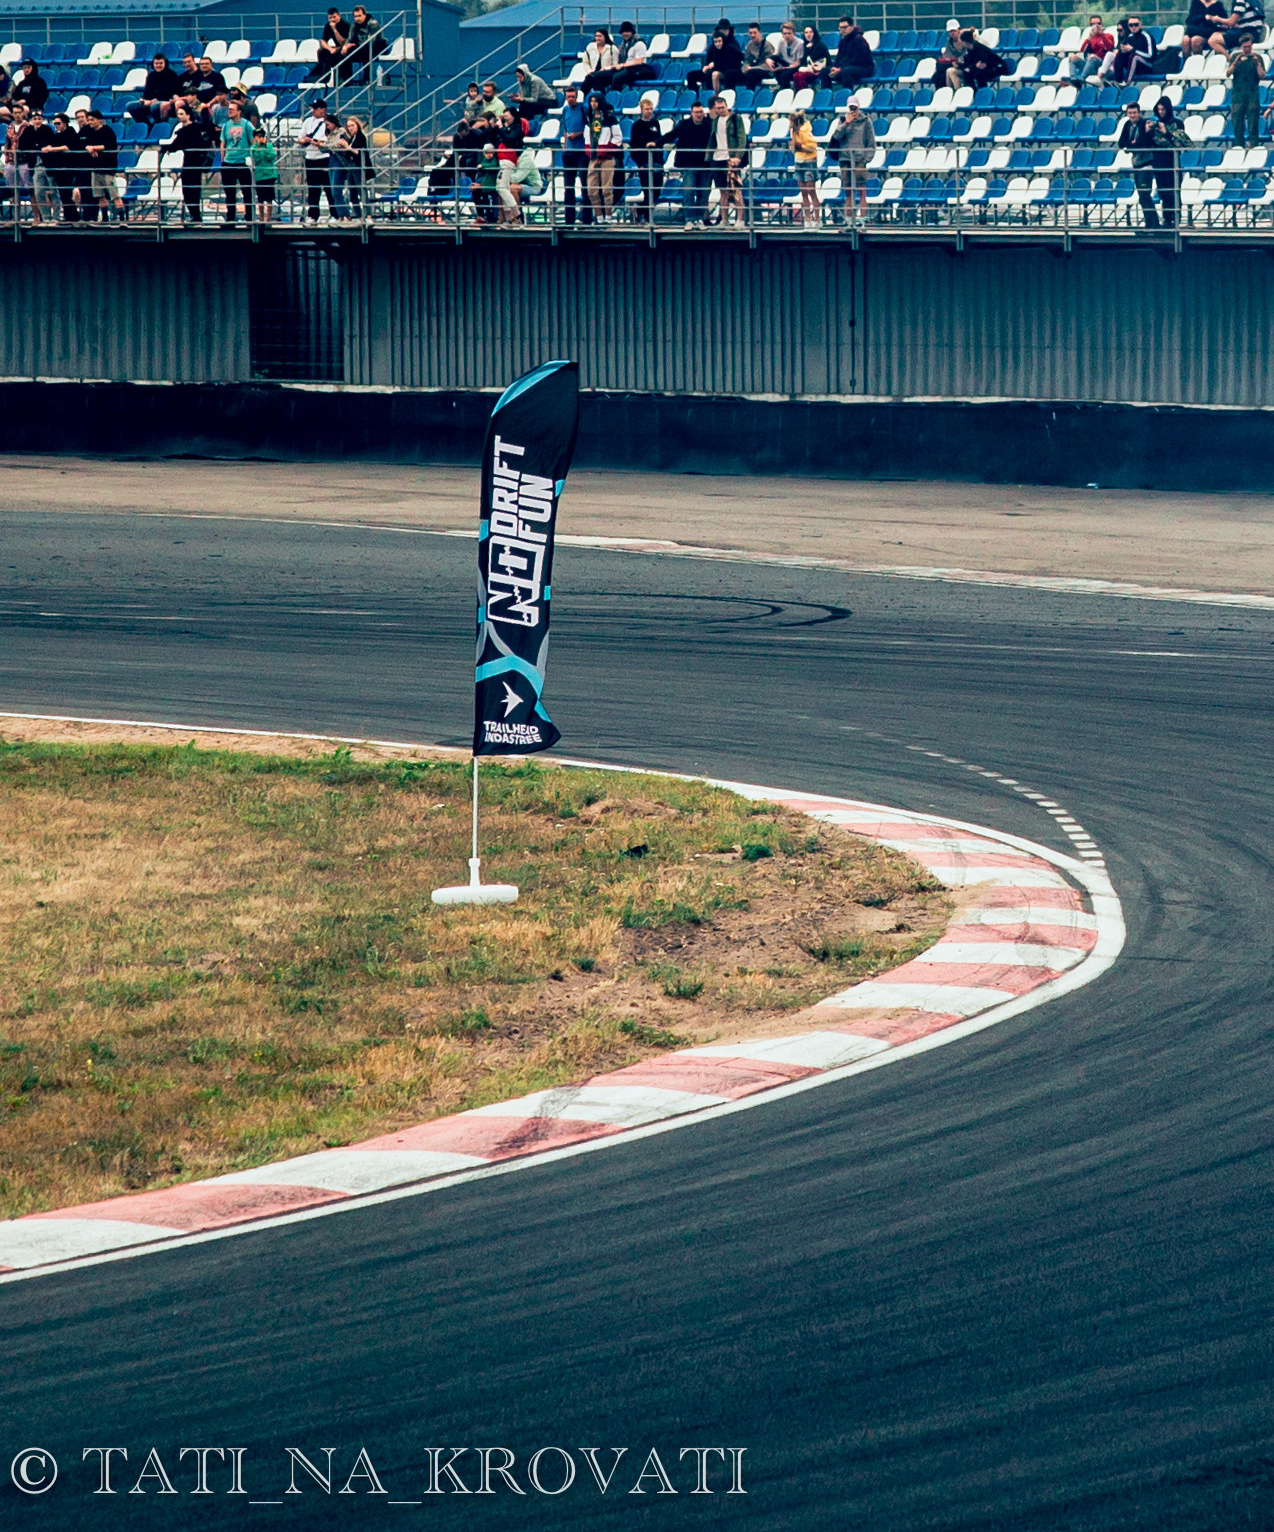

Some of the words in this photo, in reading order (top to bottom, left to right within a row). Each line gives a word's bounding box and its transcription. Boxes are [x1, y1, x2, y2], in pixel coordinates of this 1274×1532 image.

[490, 435, 525, 537] DRIFT
[518, 473, 553, 543] FUN
[483, 720, 539, 735] TRAILHEAD
[484, 732, 543, 745] INDASTREE
